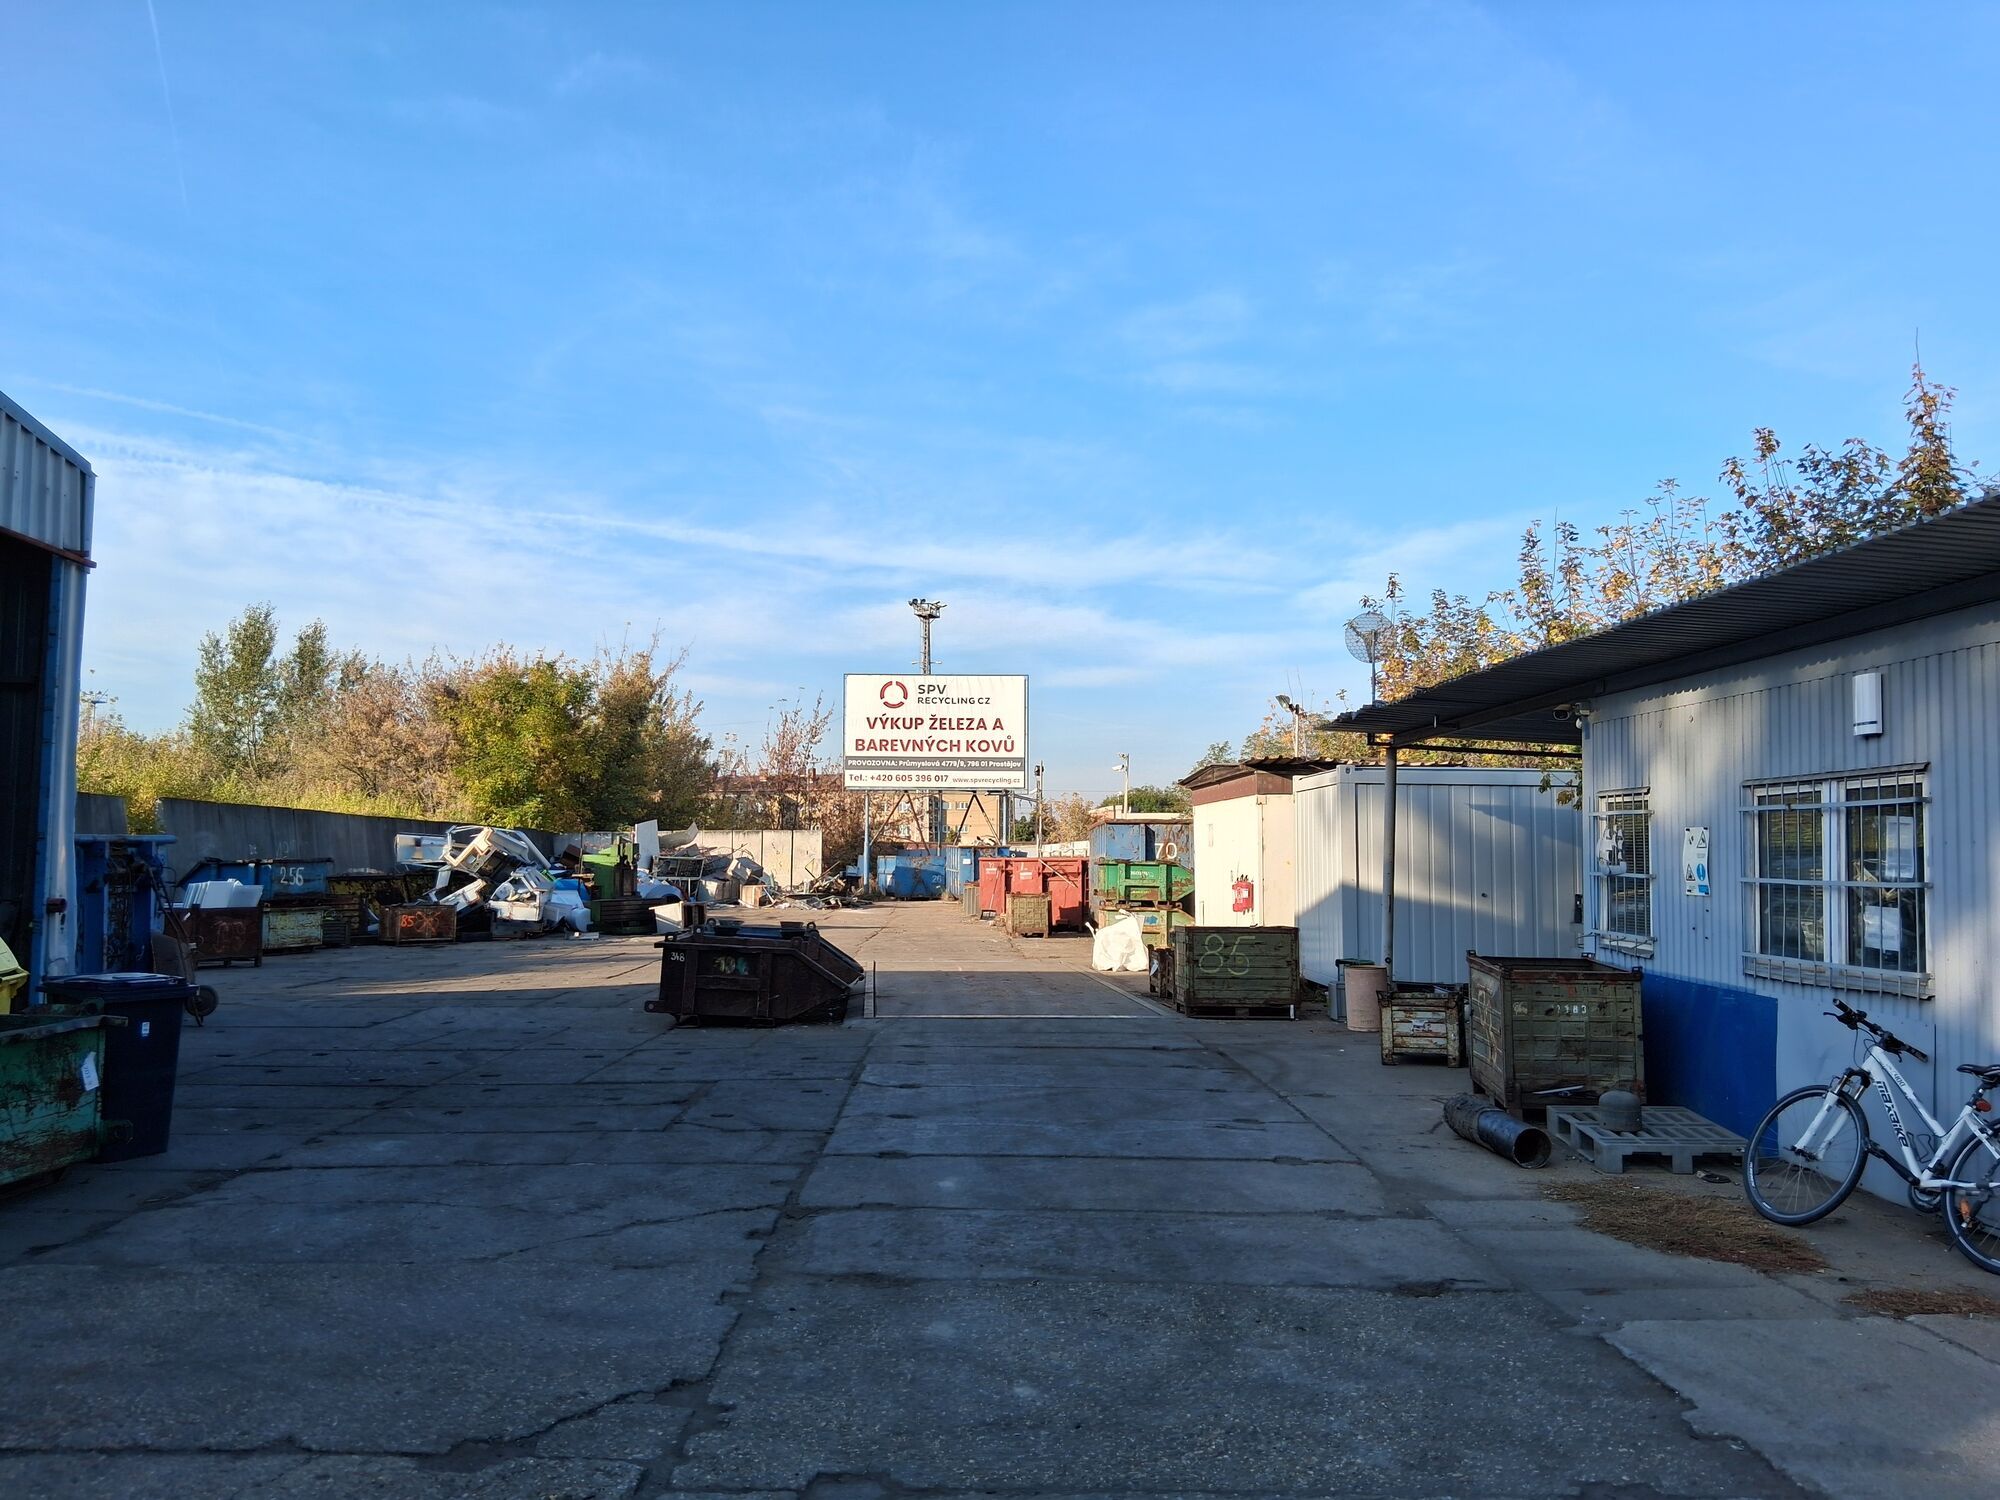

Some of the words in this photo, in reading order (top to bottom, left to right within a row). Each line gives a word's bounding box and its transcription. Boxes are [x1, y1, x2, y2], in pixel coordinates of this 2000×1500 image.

[918, 684, 947, 695] SPV
[917, 697, 975, 705] RECYCLING
[866, 713, 925, 731] VÝKUP
[929, 713, 988, 731] ŽELEZA
[992, 717, 1005, 731] A
[855, 735, 961, 753] BAREVNÝCH
[965, 735, 1015, 753] KOVŮ
[847, 759, 898, 767] PROVOZOVNA:
[899, 759, 940, 768] Průmyslová
[849, 774, 868, 782] Tel.:
[870, 774, 893, 782] +420
[895, 774, 913, 782] 605
[915, 774, 932, 782] 396
[934, 774, 949, 782] 017
[952, 776, 1020, 785] www.spvrecycling.cz
[1154, 842, 1178, 860] 70
[280, 866, 305, 887] 256
[401, 914, 416, 929] 85
[670, 951, 685, 962] 348
[1198, 933, 1256, 976] 85
